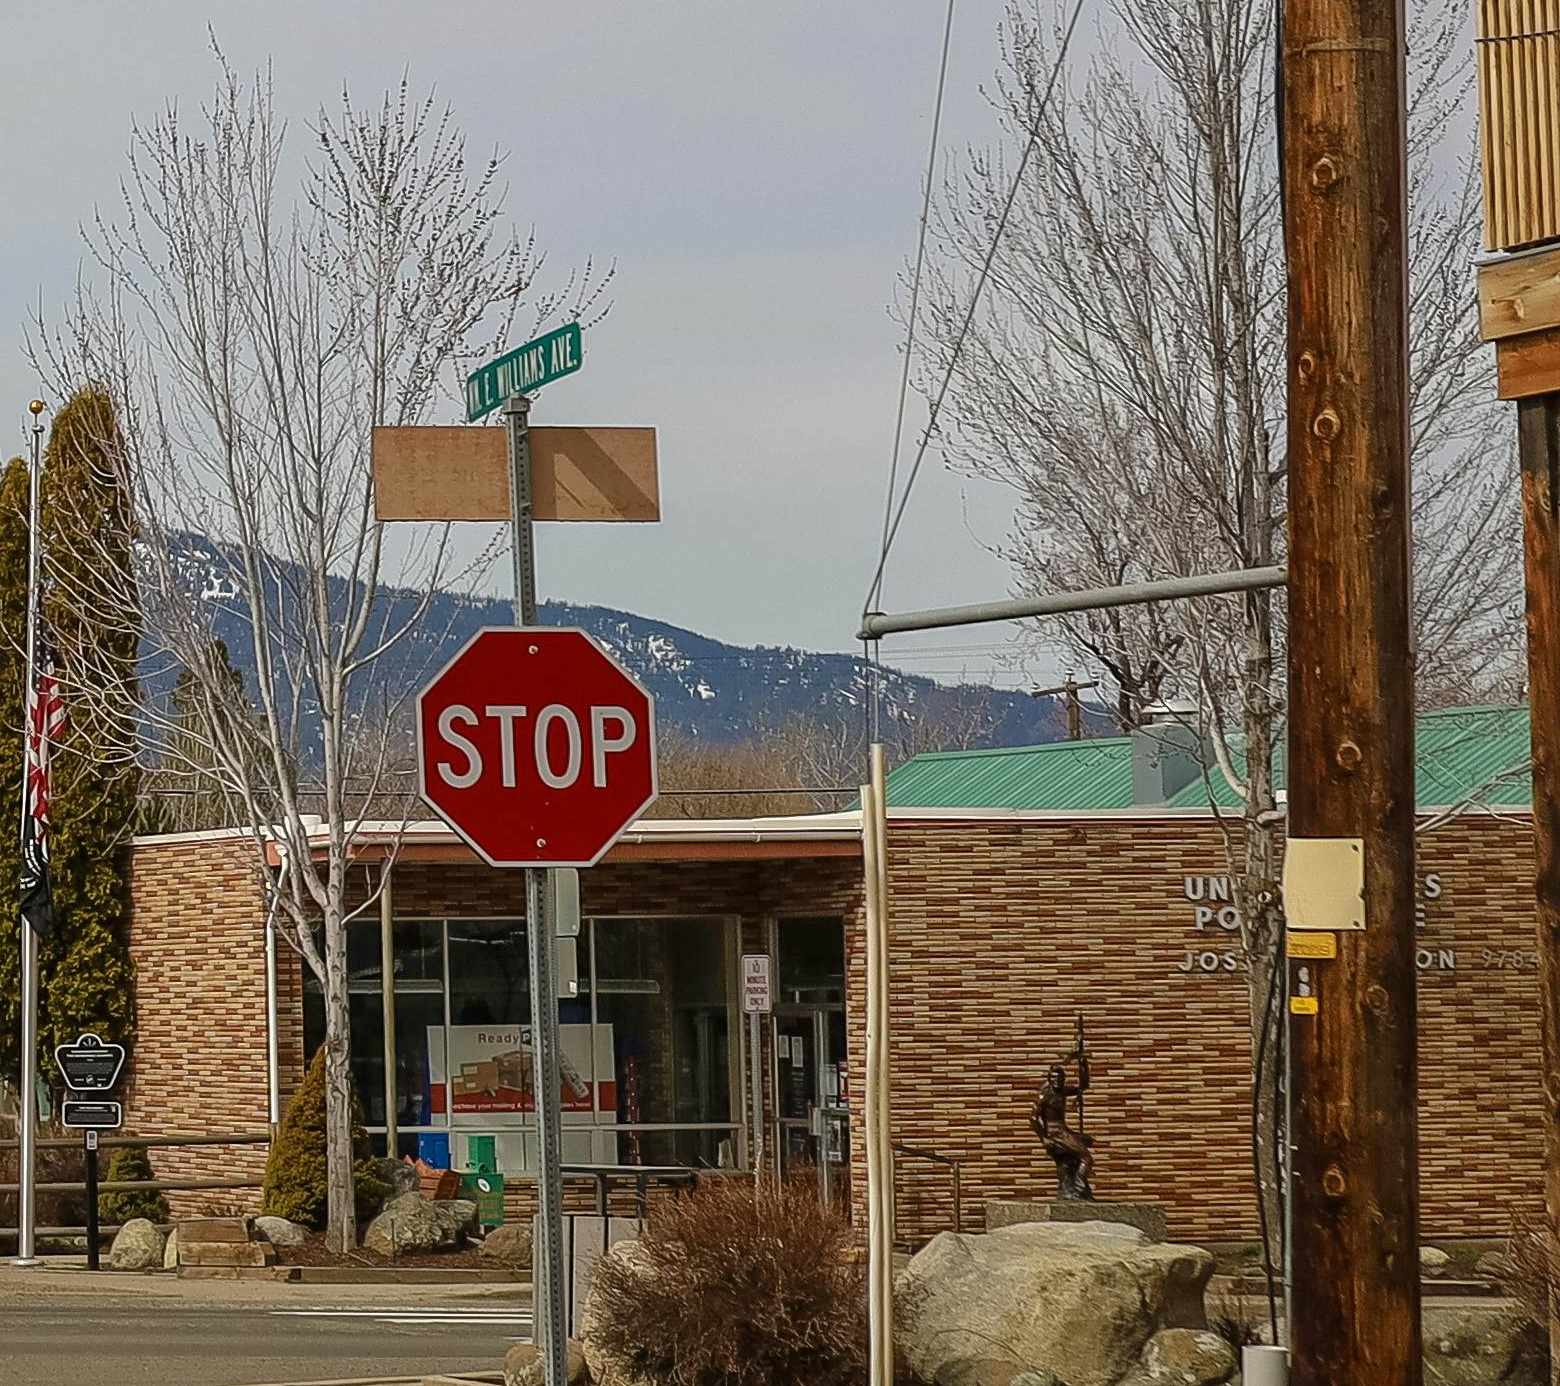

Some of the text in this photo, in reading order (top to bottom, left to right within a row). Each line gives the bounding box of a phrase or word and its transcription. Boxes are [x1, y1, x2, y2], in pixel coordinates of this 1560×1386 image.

[496, 345, 545, 399] WILLIAMS
[437, 703, 637, 789] STOP
[1194, 905, 1241, 931] PO
[1178, 951, 1246, 972] JOS
[478, 1029, 533, 1046] ReadyP
